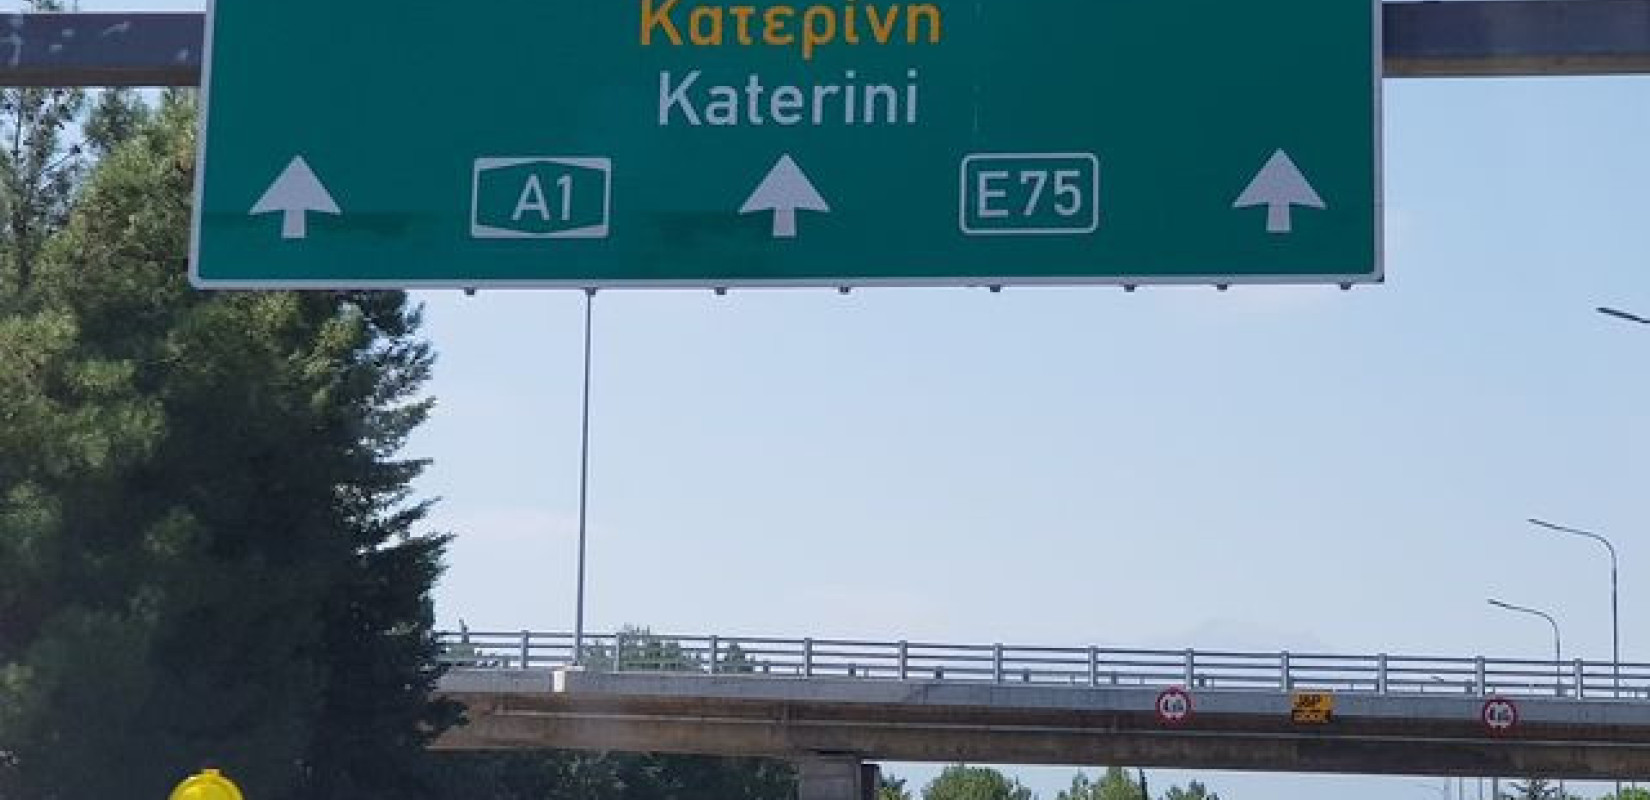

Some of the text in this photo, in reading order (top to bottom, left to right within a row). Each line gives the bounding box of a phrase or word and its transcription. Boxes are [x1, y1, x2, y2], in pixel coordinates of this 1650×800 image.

[640, 0, 942, 60] Κατερίνη
[658, 68, 918, 126] Katerini
[511, 174, 574, 222] A1
